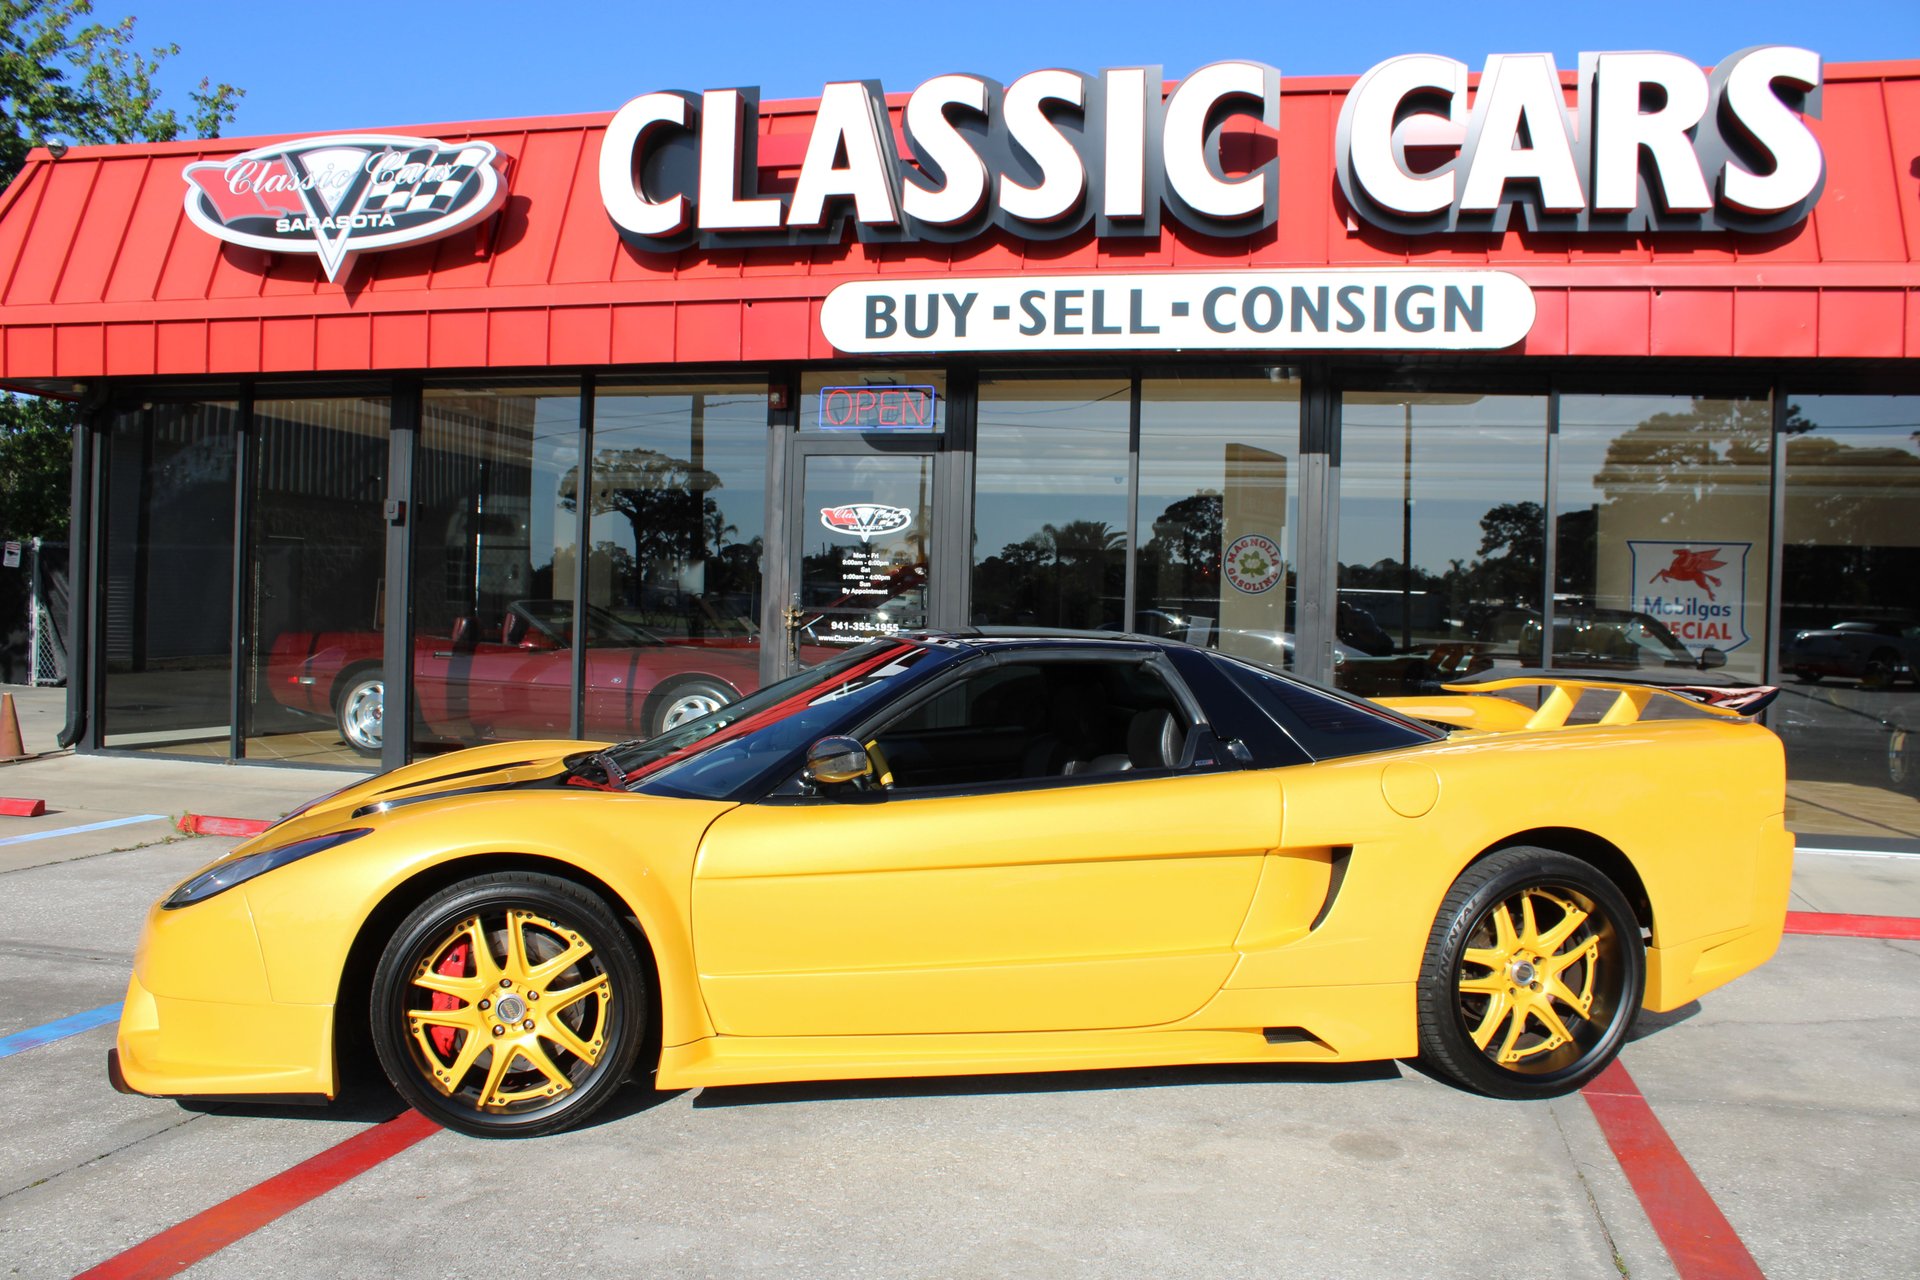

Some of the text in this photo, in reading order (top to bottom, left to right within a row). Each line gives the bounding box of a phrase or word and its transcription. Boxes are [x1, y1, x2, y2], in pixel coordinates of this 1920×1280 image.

[598, 46, 1824, 239] CLASSIC CARS
[223, 150, 460, 196] Classic Cars
[275, 213, 396, 233] SARASOTA
[864, 284, 1486, 339] BUY SELL CONSIGN
[825, 388, 925, 425] OPEN
[1227, 538, 1280, 567] MAGNOLIA
[1227, 567, 1279, 591] GASOLINE
[1643, 596, 1732, 621] Mobilgas
[831, 621, 899, 632] 941-355-1955
